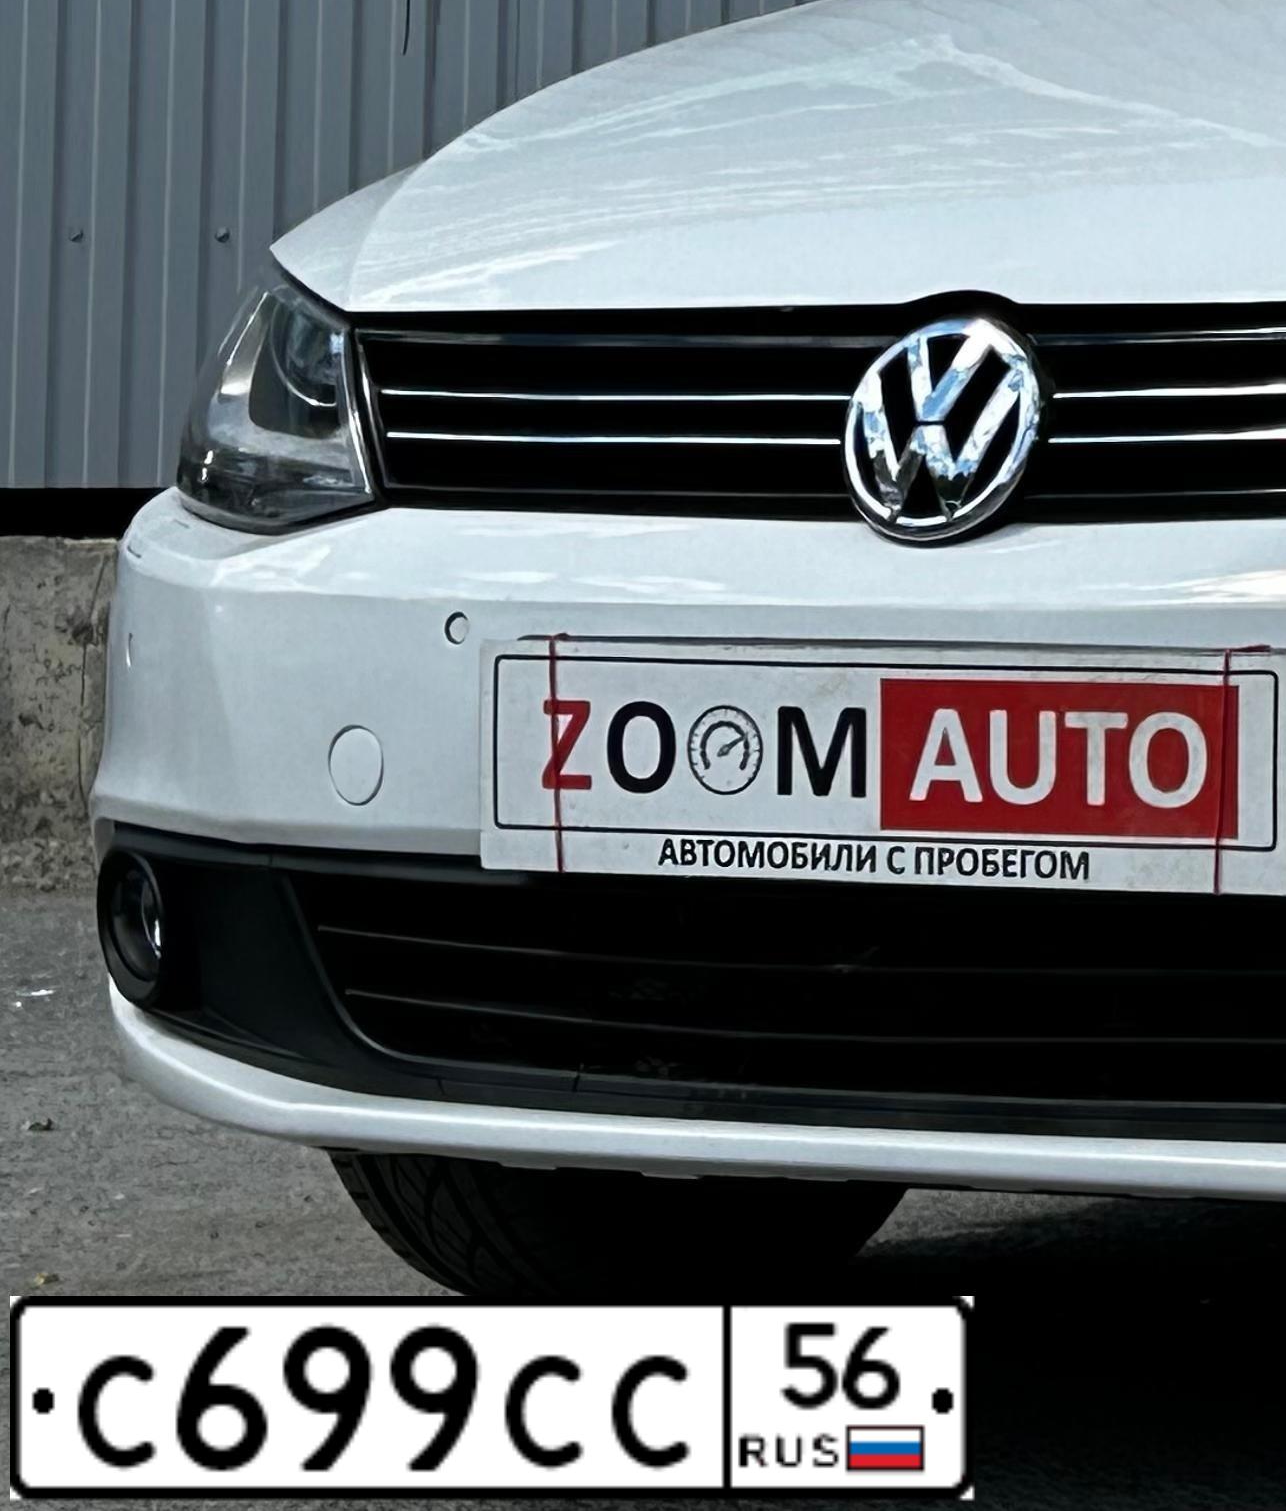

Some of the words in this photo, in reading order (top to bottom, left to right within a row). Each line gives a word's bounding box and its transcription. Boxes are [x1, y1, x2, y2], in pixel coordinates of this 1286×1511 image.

[909, 708, 1208, 808] AUTO
[657, 838, 877, 873] АВТОМОБИЛИ
[886, 845, 906, 875] С
[914, 846, 1090, 880] ПРОБЕГОМ
